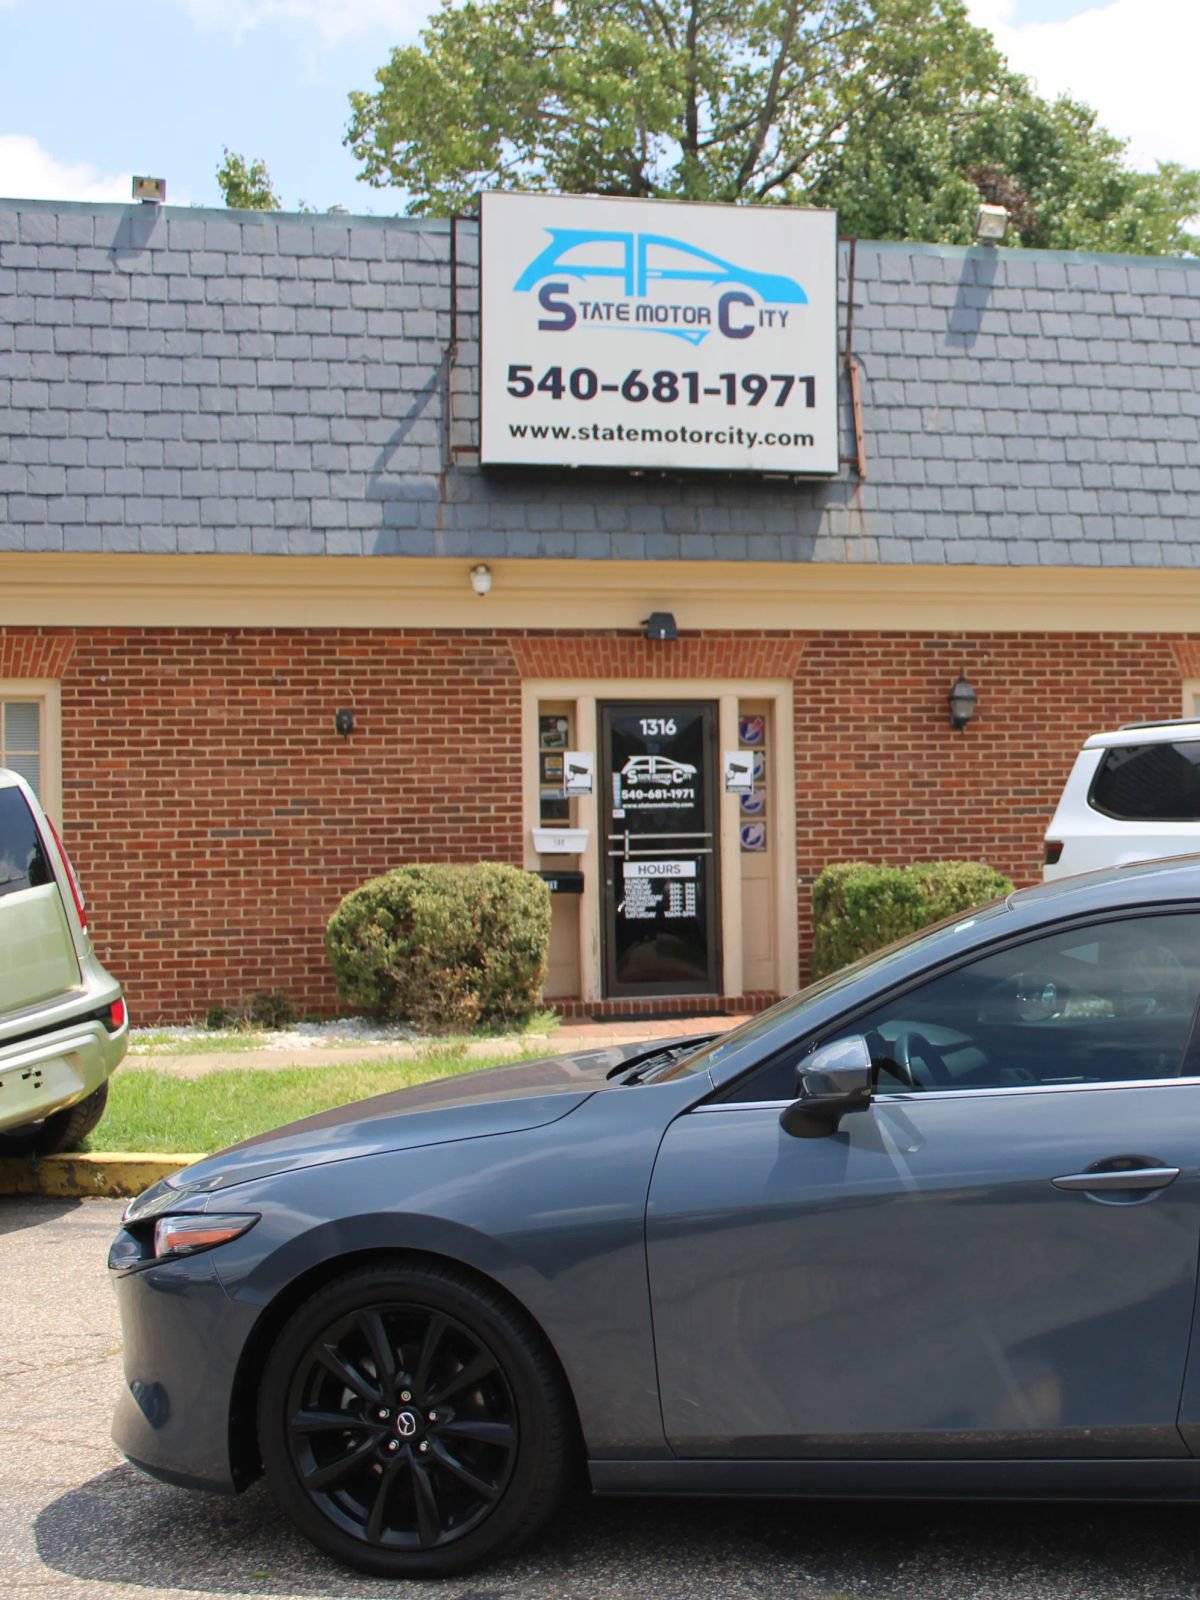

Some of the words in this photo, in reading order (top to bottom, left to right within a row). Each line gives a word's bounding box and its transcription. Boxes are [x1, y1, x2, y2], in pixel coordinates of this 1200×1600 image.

[636, 304, 711, 325] MOTOR
[506, 364, 816, 408] 540-681-1971
[509, 423, 815, 448] www.statemotorcity.com
[640, 718, 677, 736] 1316
[621, 788, 695, 800] 540-681-1971
[638, 864, 681, 875] HOURS
